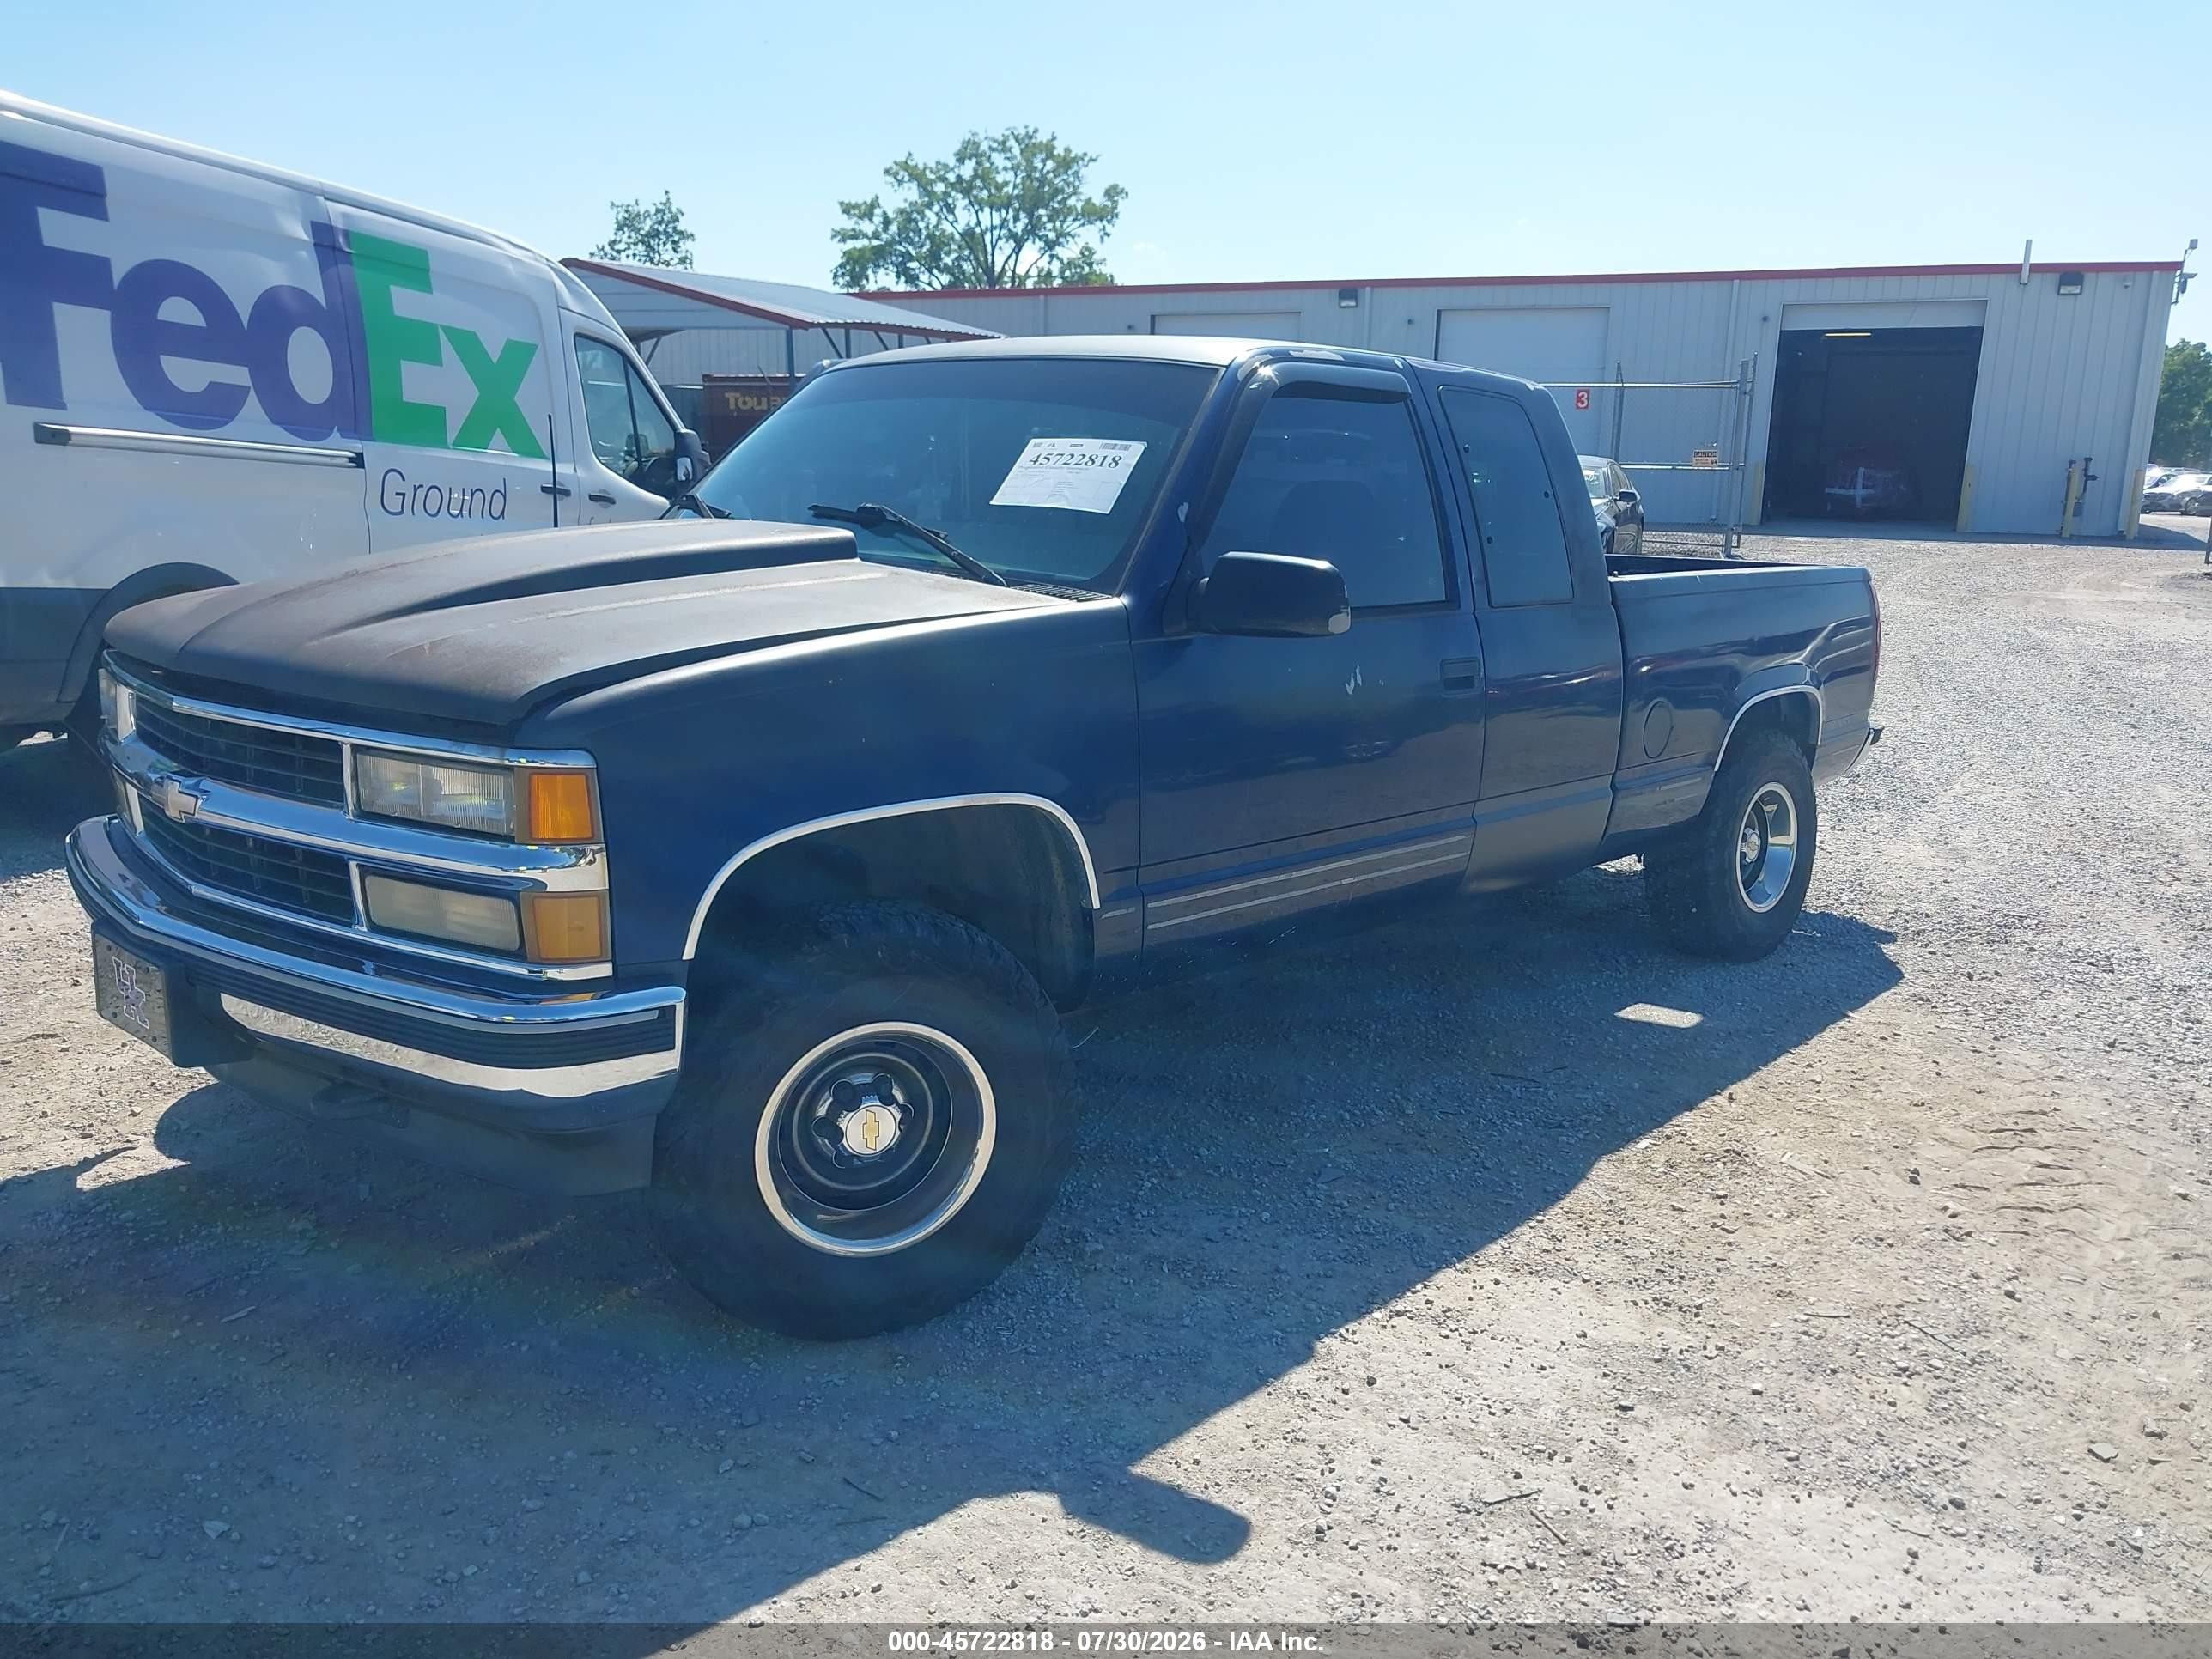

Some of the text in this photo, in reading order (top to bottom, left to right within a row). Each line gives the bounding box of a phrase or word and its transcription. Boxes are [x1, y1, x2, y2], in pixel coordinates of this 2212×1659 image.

[0, 140, 549, 460] FedEx
[1577, 391, 1589, 408] 3
[1029, 453, 1122, 470] 45722818
[380, 468, 507, 520] Ground
